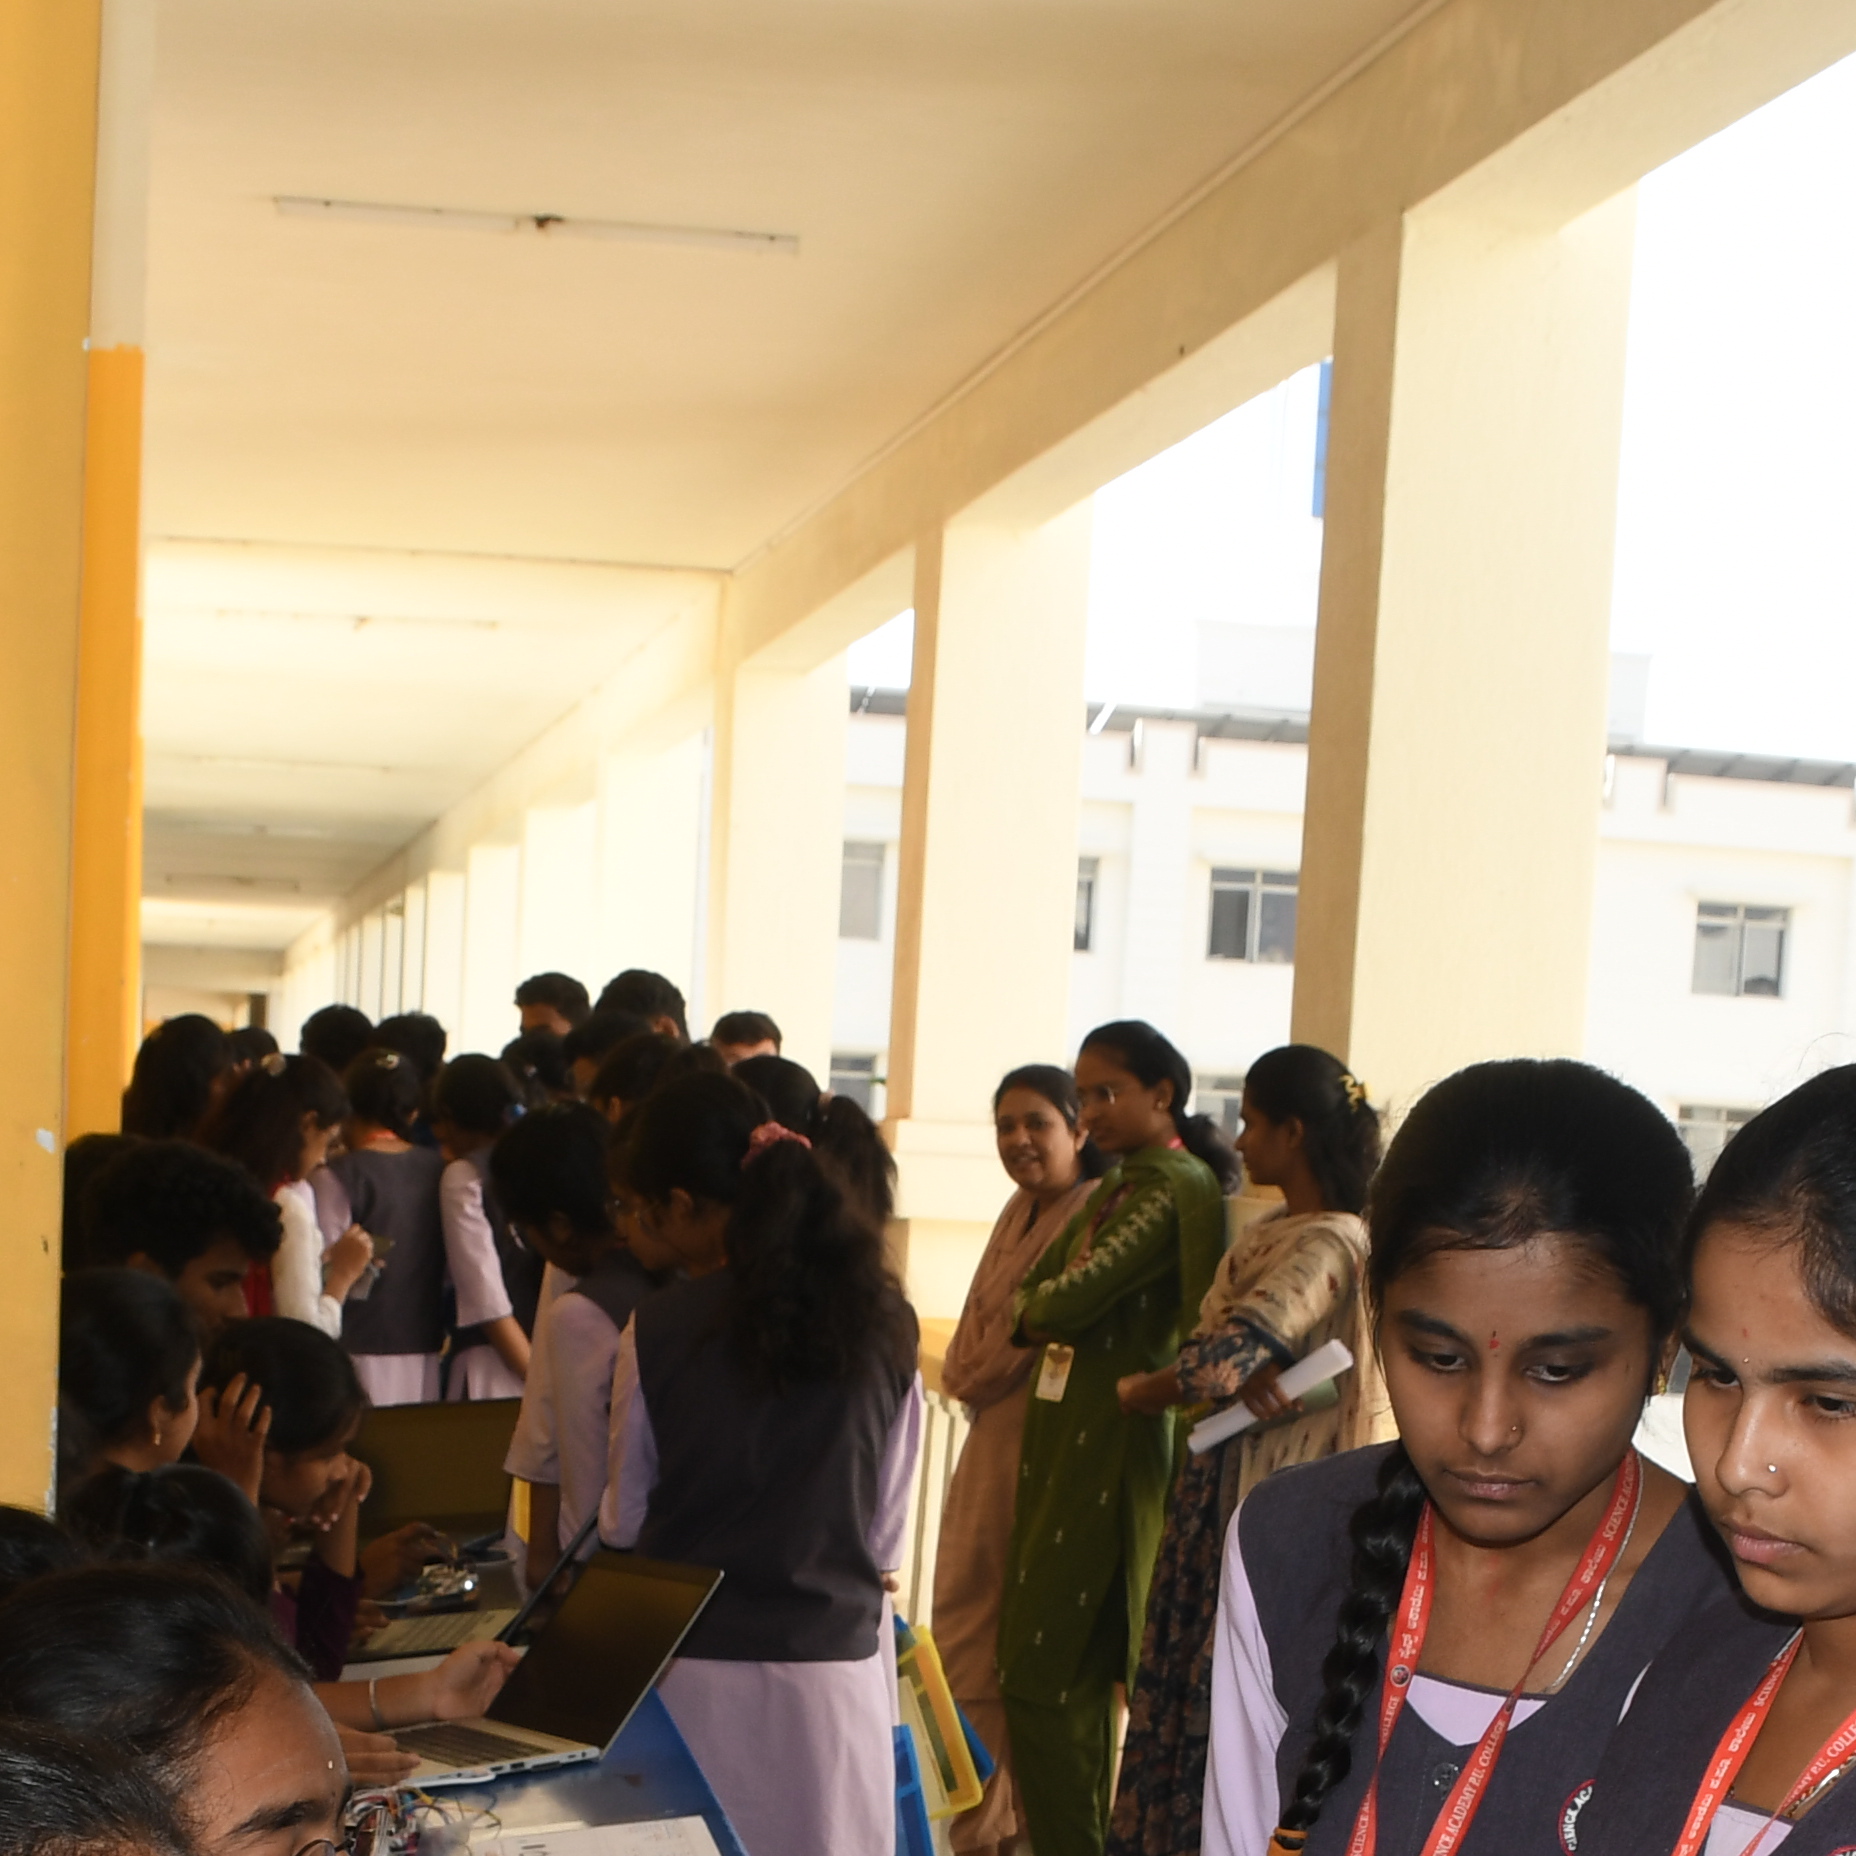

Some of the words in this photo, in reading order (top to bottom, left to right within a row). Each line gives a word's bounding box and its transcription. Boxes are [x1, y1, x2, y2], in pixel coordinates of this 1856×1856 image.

[1603, 1496, 1630, 1542] SCIENCE
[1443, 1784, 1478, 1839] ACADEMY
[1477, 1719, 1508, 1768] COLLEGE
